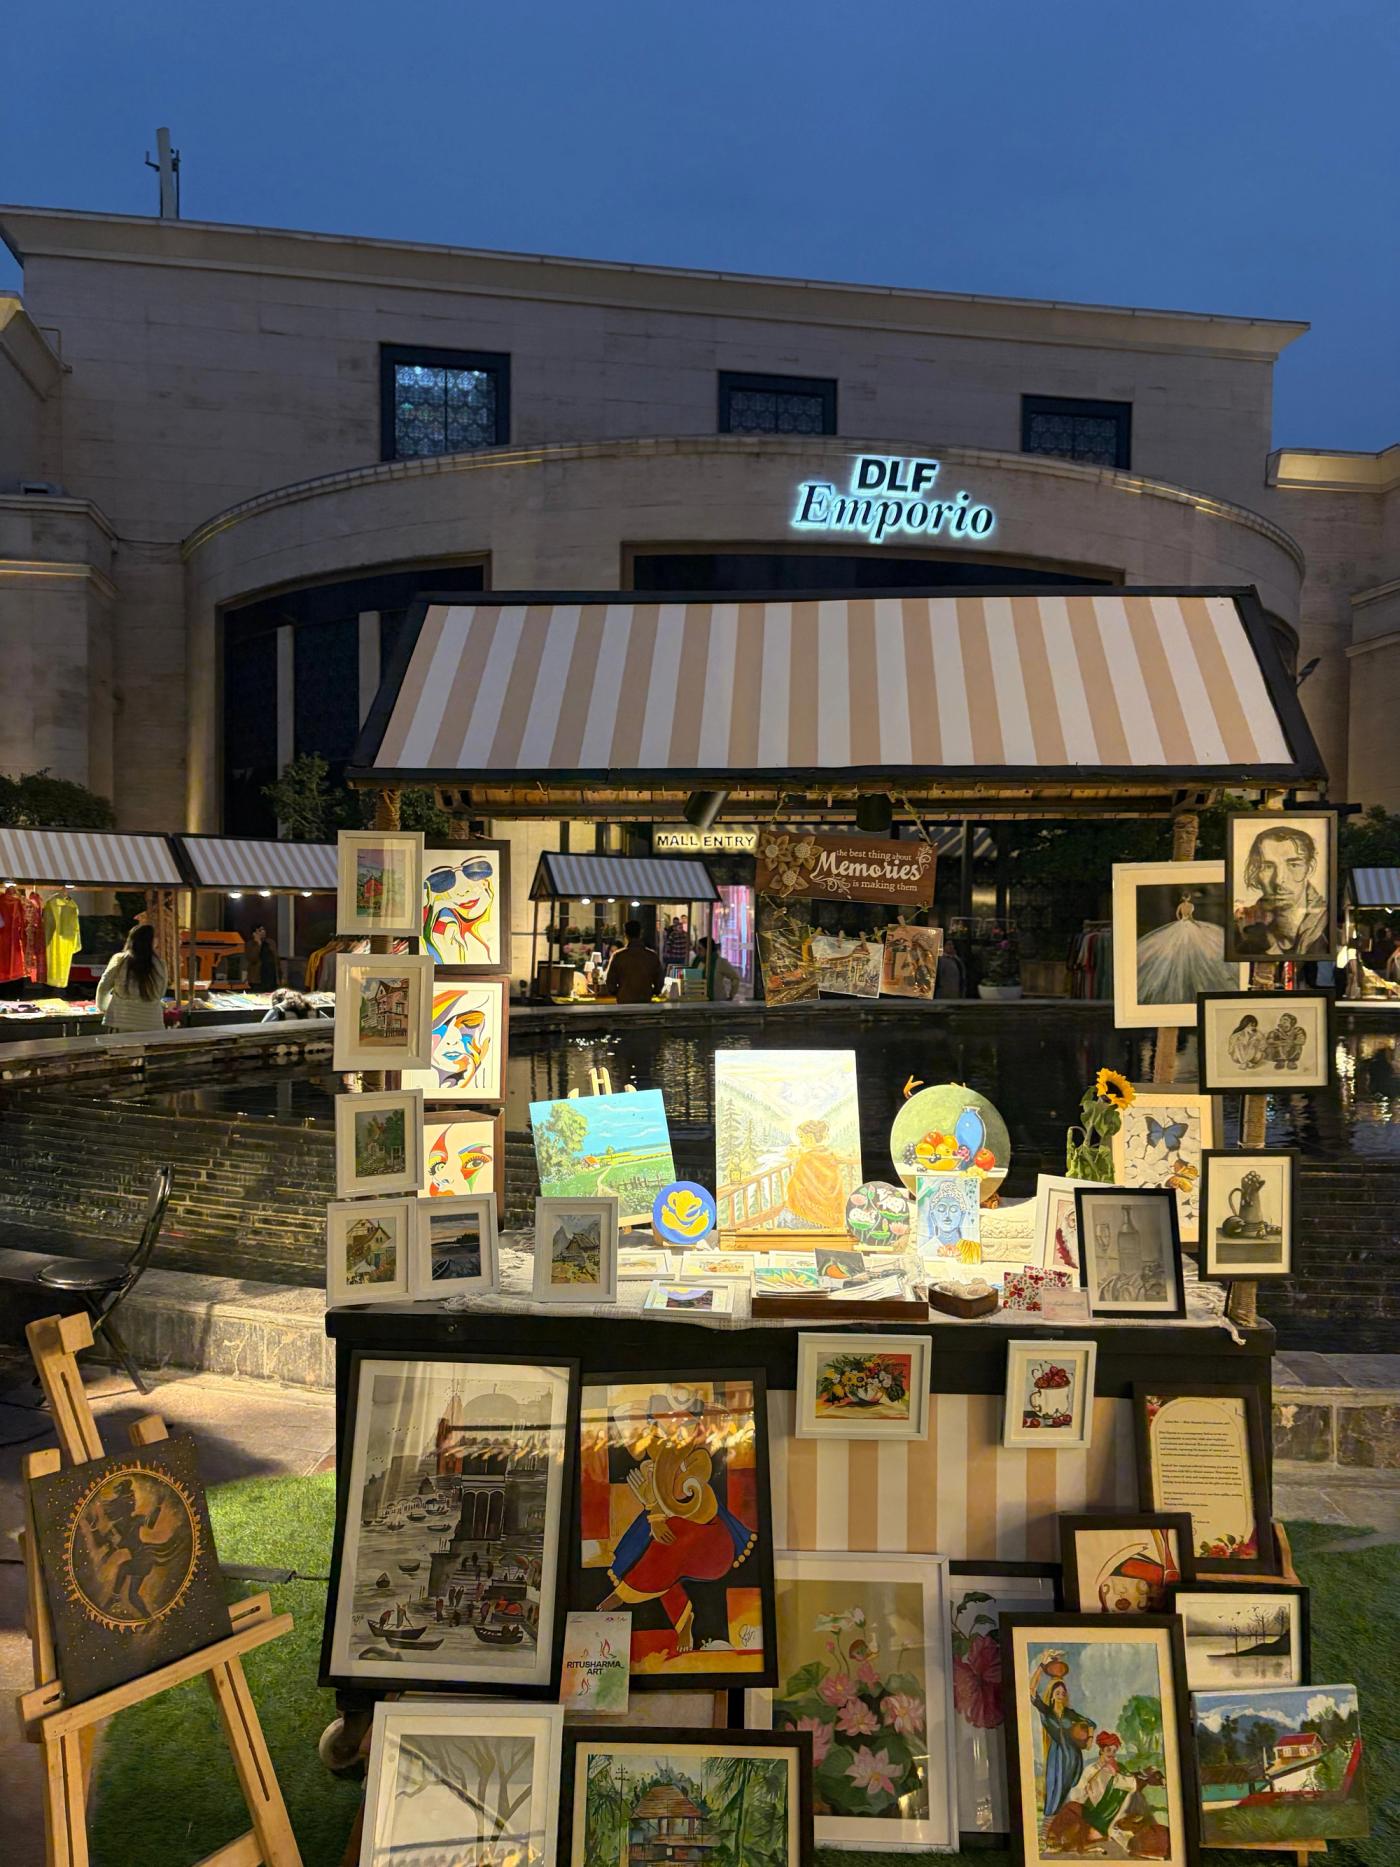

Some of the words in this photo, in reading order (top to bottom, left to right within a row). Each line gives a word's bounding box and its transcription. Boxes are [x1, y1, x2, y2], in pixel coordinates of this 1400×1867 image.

[856, 457, 938, 494] DLF
[794, 484, 994, 540] Emporio
[657, 835, 698, 846] MALL
[703, 835, 754, 847] ENTRY
[837, 849, 848, 857] the
[849, 849, 866, 858] best
[868, 850, 891, 861] thing
[892, 853, 912, 861] about
[810, 851, 922, 881] Memories
[852, 880, 860, 888] is
[861, 880, 896, 892] making
[897, 882, 918, 891] them
[567, 1661, 622, 1669] RITUSHARMA
